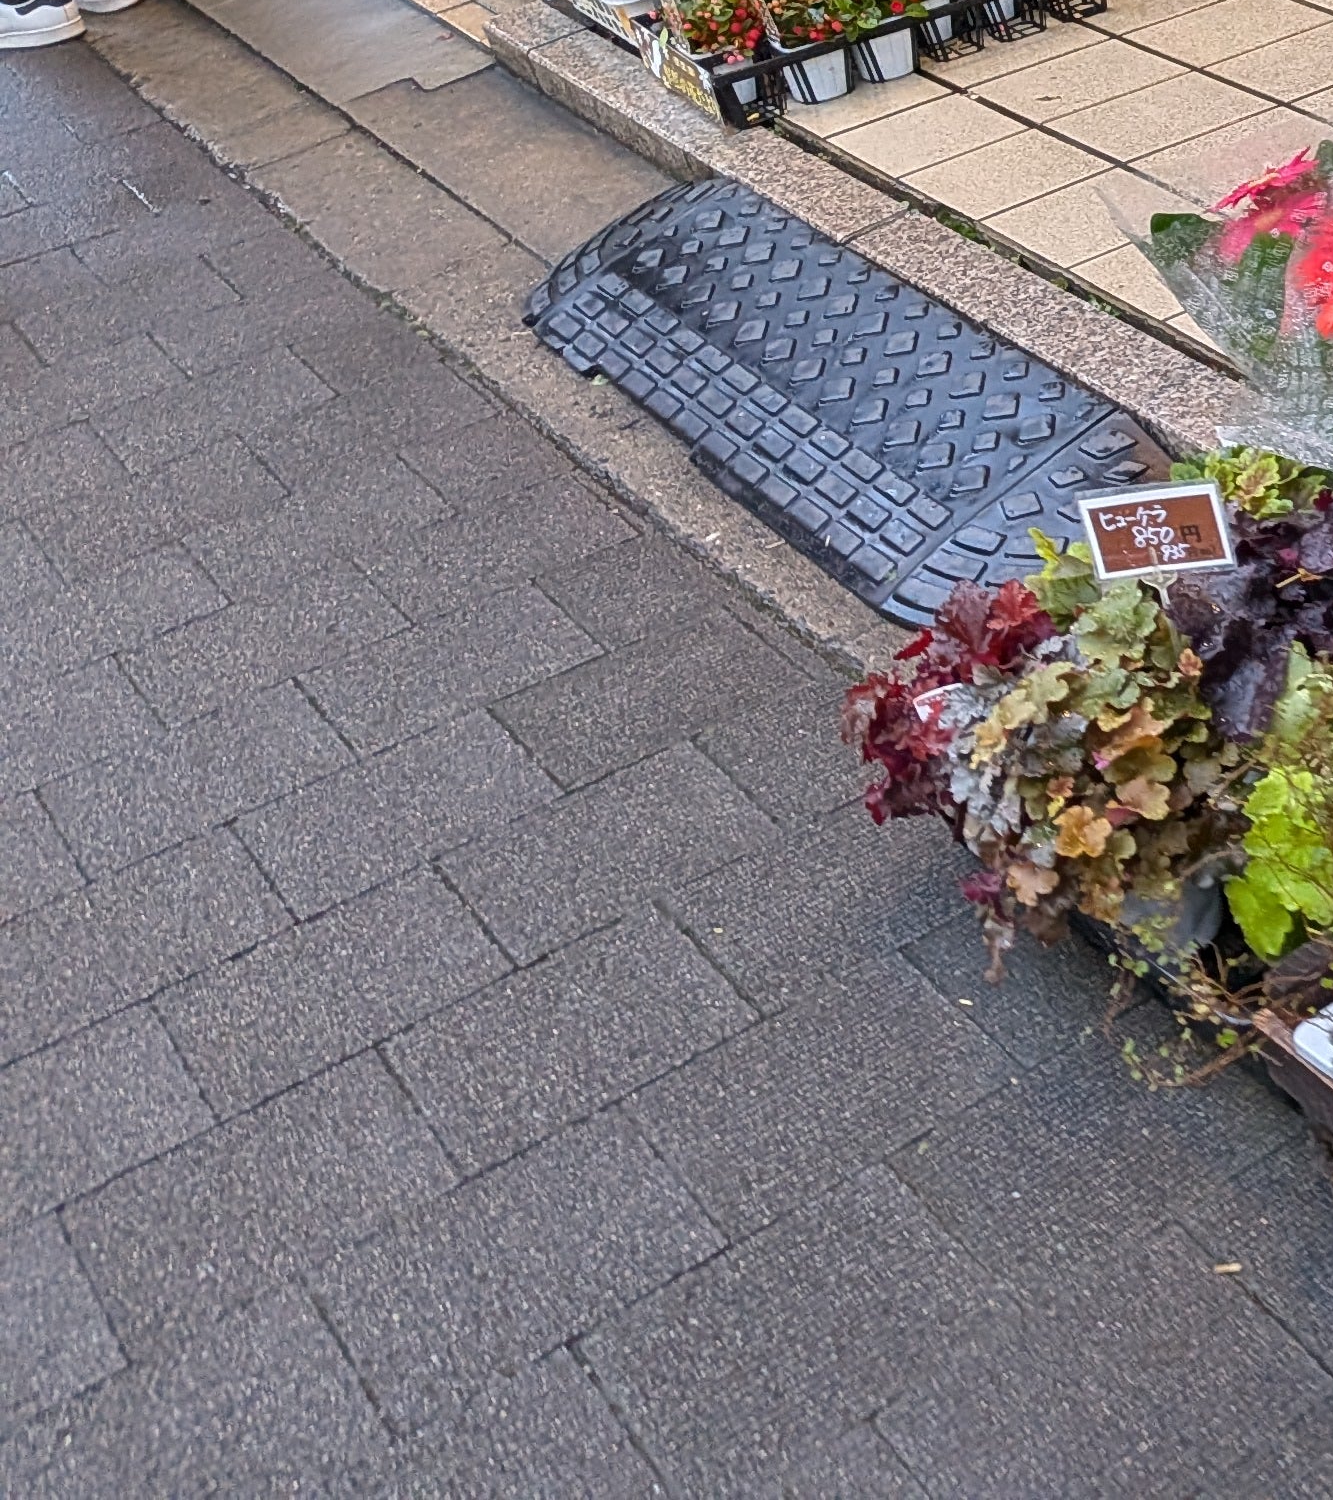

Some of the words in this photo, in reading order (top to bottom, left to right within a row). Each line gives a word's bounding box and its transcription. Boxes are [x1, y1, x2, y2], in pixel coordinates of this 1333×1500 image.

[1098, 504, 1168, 532] ヒューケラ
[1131, 525, 1175, 549] 850
